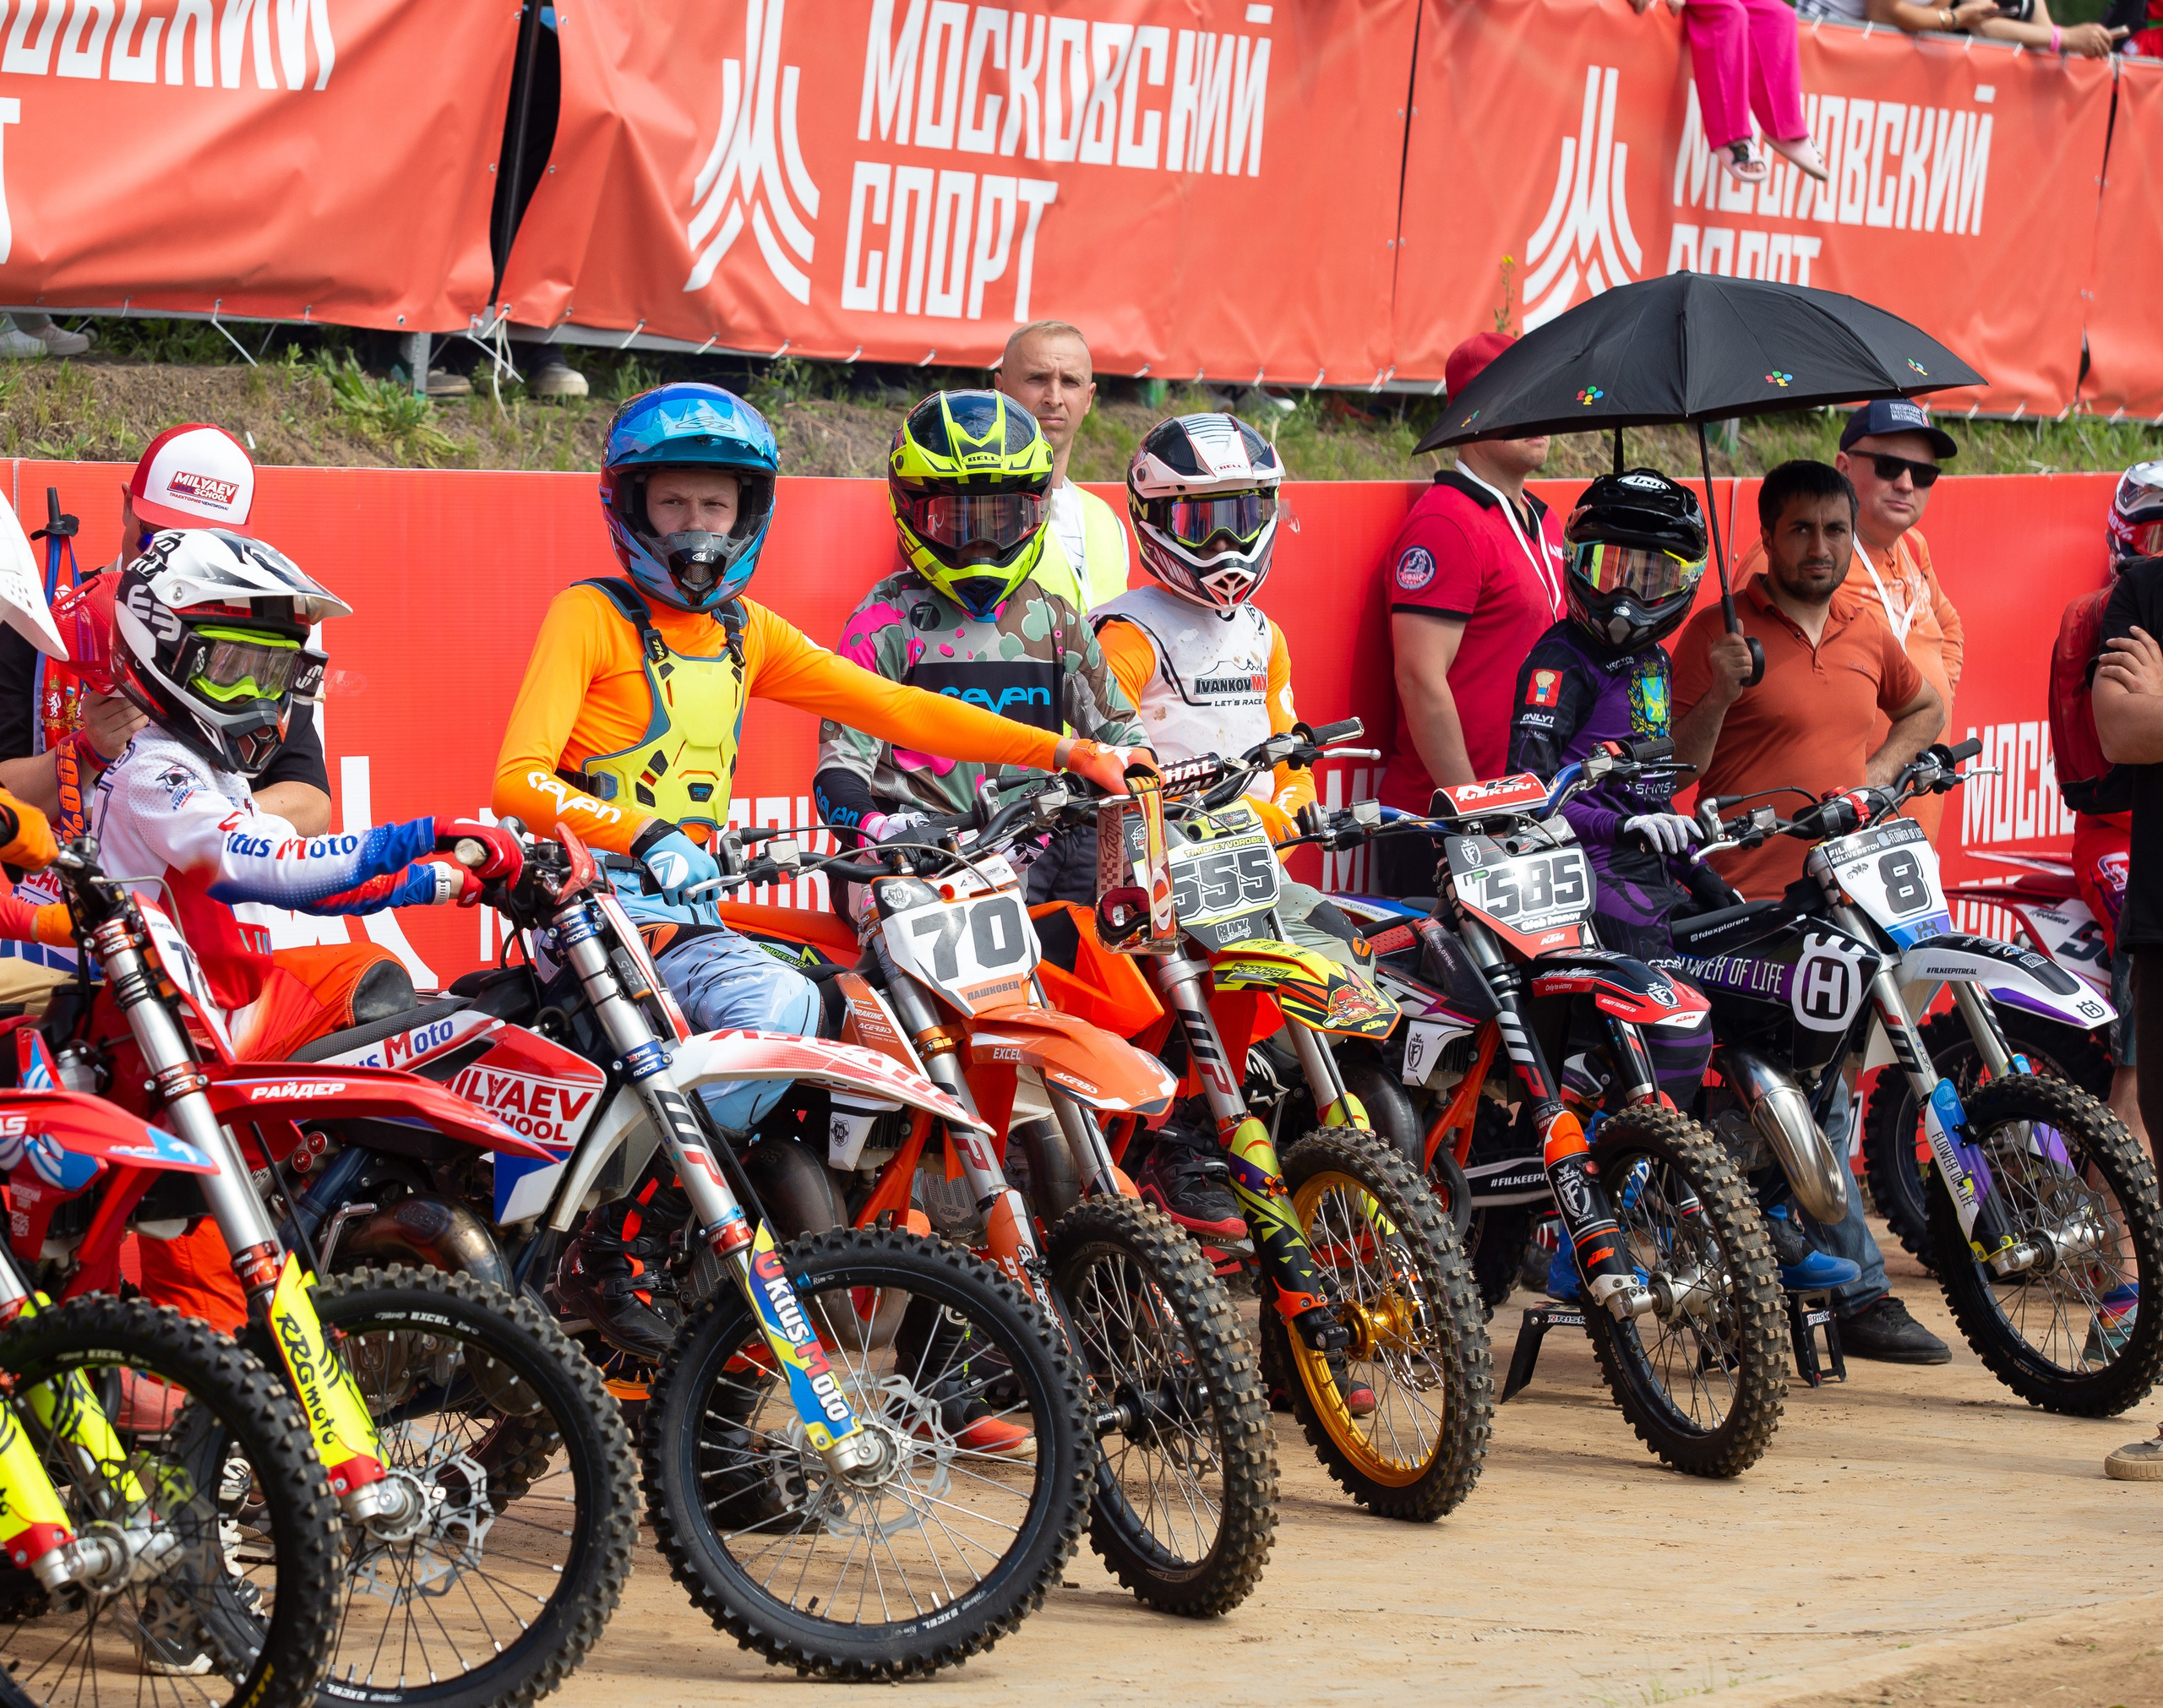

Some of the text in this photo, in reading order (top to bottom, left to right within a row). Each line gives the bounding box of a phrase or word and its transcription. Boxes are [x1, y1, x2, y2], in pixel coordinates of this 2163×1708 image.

[857, 0, 1273, 177] МОСКОВСКИЙ
[842, 160, 1059, 323] СПОРТ
[967, 454, 999, 463] BELL
[174, 472, 237, 497] MILYAEV
[1631, 477, 1663, 489] Arai
[169, 492, 202, 504] ТРАЕКТОРИЯ
[193, 488, 229, 503] SCHOOL
[1214, 699, 1240, 708] LET'S
[1163, 760, 1218, 785] HAL
[275, 833, 358, 861] Moto
[1185, 843, 1226, 858] TIMOFEY
[1225, 835, 1266, 850] VOROBEV
[1170, 847, 1279, 918] 555
[1486, 854, 1585, 920] 585
[1878, 849, 1929, 915] 8
[558, 916, 583, 929] XTRIG
[1521, 911, 1582, 931] Gleb Ivanov
[1698, 916, 1750, 940] fdexplorers
[97, 925, 123, 941] XTRIG
[566, 929, 591, 944] ROCS
[912, 896, 1027, 982] 70
[1539, 933, 1566, 945] KTM
[103, 938, 130, 955] ROCS
[759, 943, 794, 964] TIMOFEY
[618, 960, 639, 987] 225
[1728, 958, 1753, 987] OF
[1751, 959, 1785, 995] LIFE
[1926, 966, 1977, 976] #FILKEEPITREAL
[967, 980, 1021, 1002] ПАШКОВЕЦ
[1545, 983, 1555, 992] Only
[1559, 982, 1572, 991] victory
[1601, 998, 1613, 1007] READY
[1618, 1003, 1631, 1012] RACE
[858, 1022, 893, 1035] ACERBIS
[1361, 1020, 1389, 1032] KTM
[1675, 1014, 1696, 1024] KTM
[383, 1020, 454, 1069] Moto
[993, 1047, 1022, 1061] EXCEL
[627, 1047, 651, 1063] XTRIG
[158, 1066, 184, 1082] XTRIG
[634, 1062, 658, 1077] ROCS
[165, 1080, 191, 1097] ROCS
[251, 1081, 346, 1100] РАЙДЕР
[1054, 1072, 1098, 1095] ACERBIS
[444, 1068, 594, 1122] ILYAEV
[642, 1093, 662, 1123] XACT
[483, 1107, 569, 1142] CHOOL
[1931, 1130, 1959, 1172] FLOWER
[1957, 1184, 1977, 1210] LIFE
[1587, 1246, 1615, 1268] KTM
[813, 1275, 826, 1286] Rim
[410, 1311, 451, 1326] EXCEL
[1555, 1314, 1586, 1325] RISK
[1811, 1310, 1830, 1325] RISK
[755, 1249, 852, 1423] Uktus Moto
[88, 1349, 126, 1361] EXCEL
[922, 1607, 959, 1629] EXCEL
[327, 1682, 368, 1701] EXCEL
